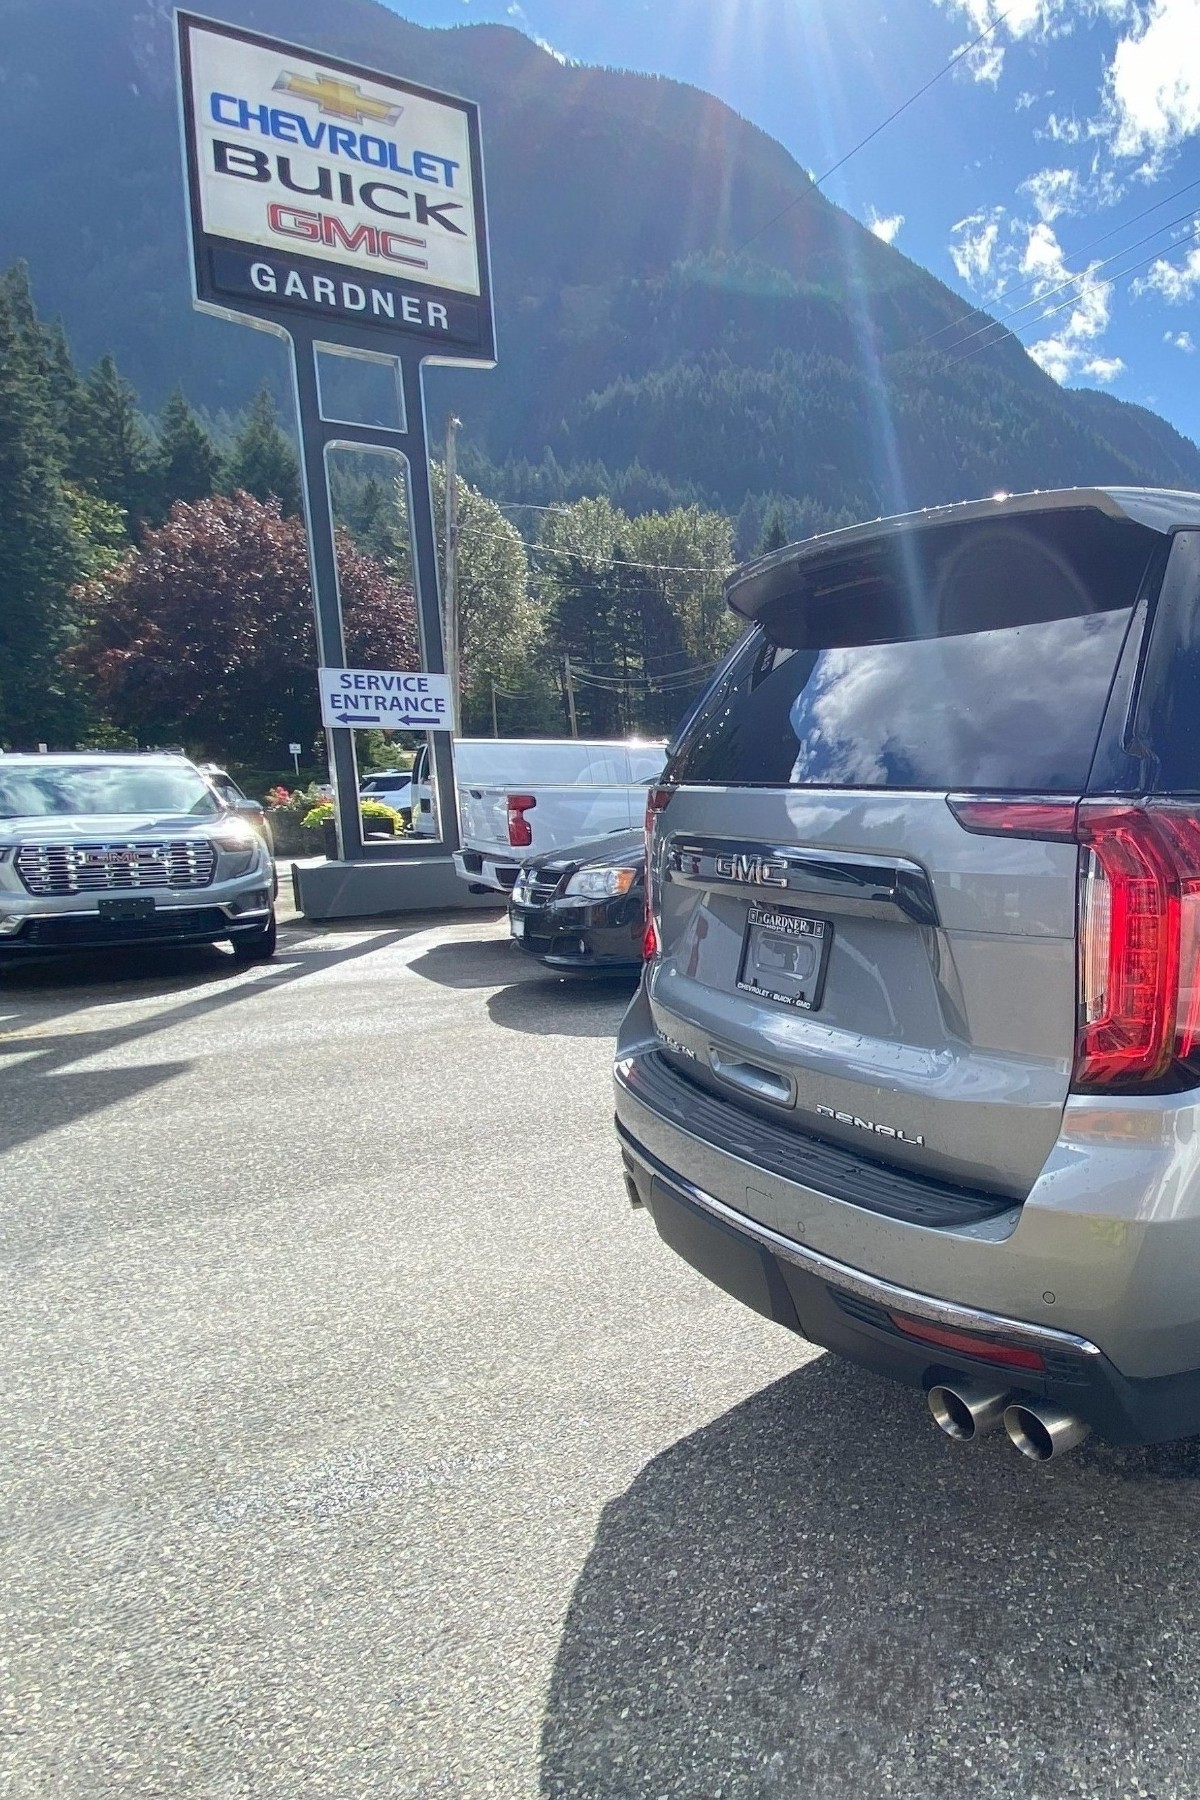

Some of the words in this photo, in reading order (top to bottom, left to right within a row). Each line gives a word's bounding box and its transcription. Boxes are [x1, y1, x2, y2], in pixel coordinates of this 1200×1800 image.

[210, 92, 459, 188] CHEVROLET
[212, 139, 468, 236] BUICK
[267, 202, 428, 269] GMC
[251, 263, 449, 330] GARDNER
[340, 674, 429, 692] SERVICE
[330, 694, 446, 713] ENTRANCE
[716, 853, 788, 888] GMC
[763, 913, 807, 931] GARDNER
[737, 982, 770, 997] CHEVROLET
[773, 993, 793, 1004] BUICK
[796, 1000, 811, 1010] GMC
[816, 1103, 924, 1147] DENALI
